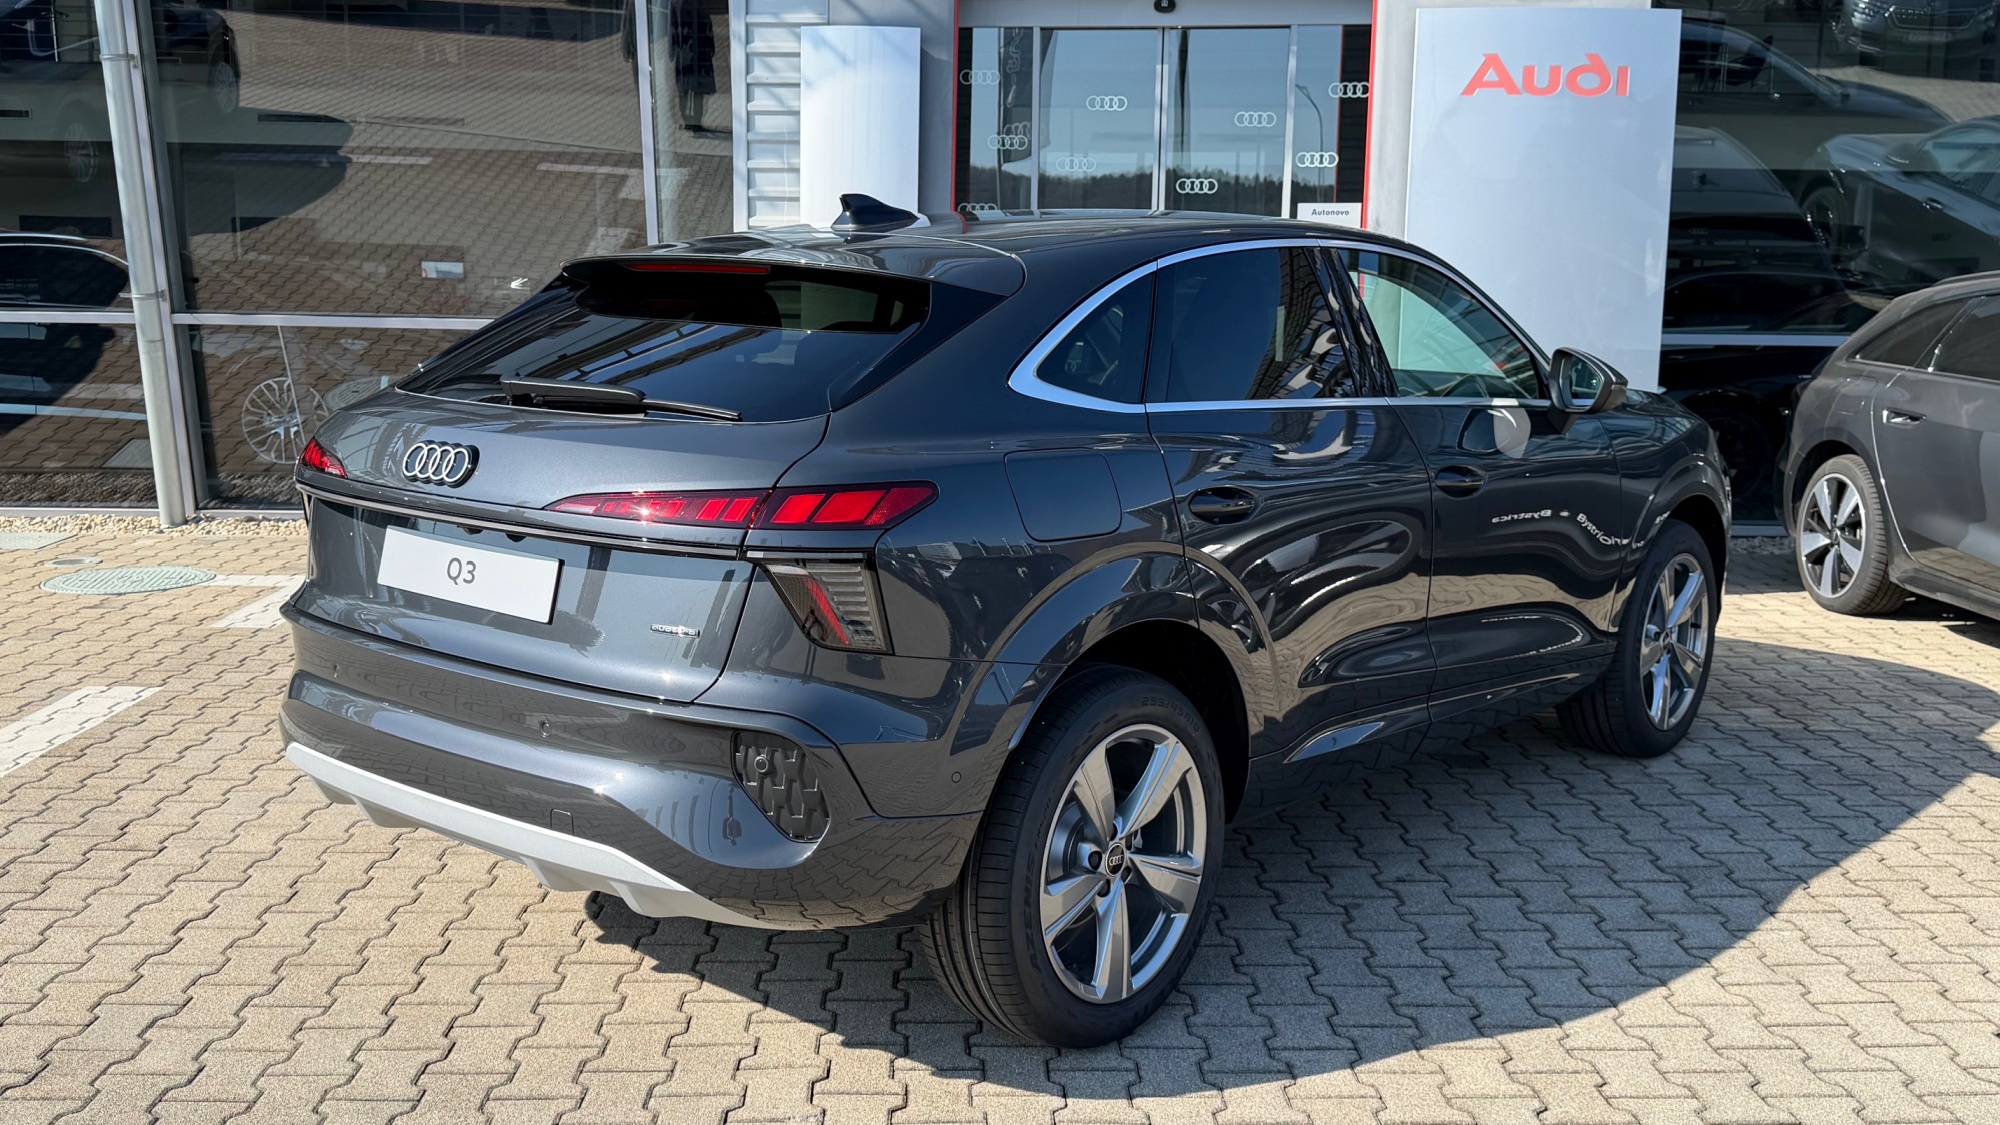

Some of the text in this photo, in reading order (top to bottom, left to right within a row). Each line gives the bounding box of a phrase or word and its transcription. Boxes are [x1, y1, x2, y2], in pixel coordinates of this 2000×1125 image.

[1460, 53, 1630, 97] Audi
[1311, 208, 1350, 216] Autonovo
[447, 557, 477, 585] Q3
